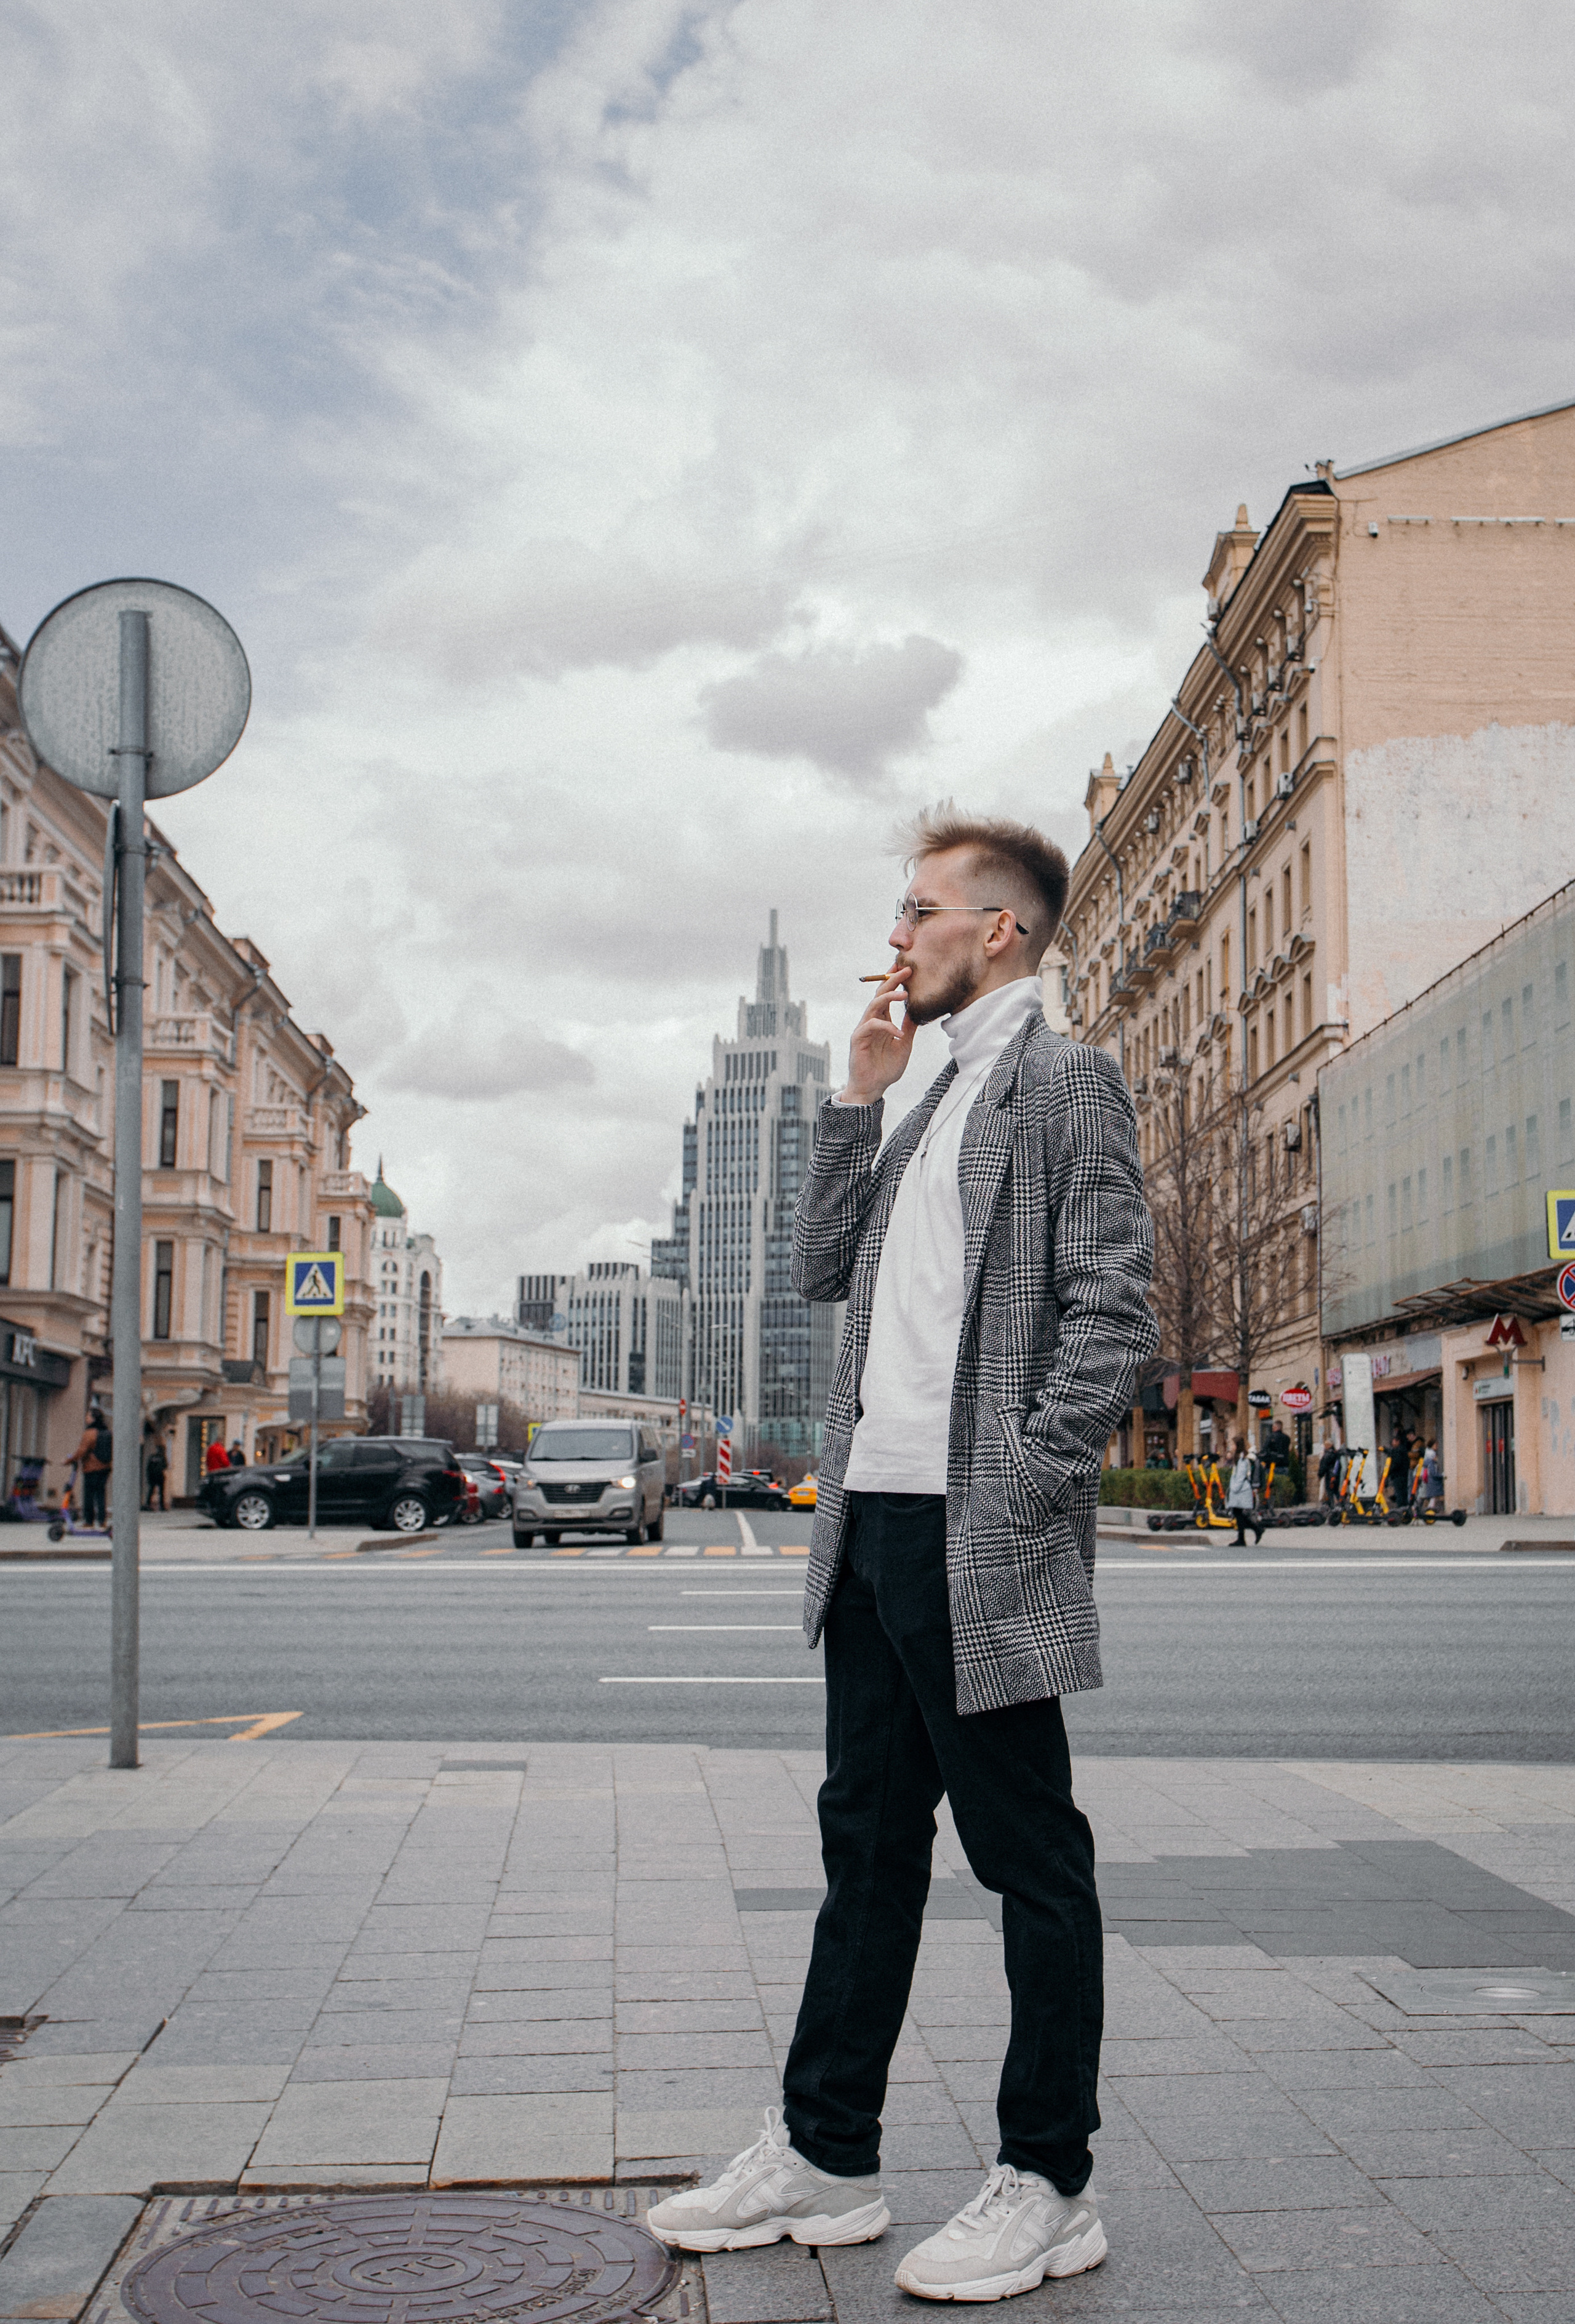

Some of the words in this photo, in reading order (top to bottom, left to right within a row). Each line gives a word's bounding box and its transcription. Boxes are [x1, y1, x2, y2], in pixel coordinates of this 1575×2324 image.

[1248, 1395, 1270, 1404] ТАБАК
[1282, 1393, 1310, 1404] ЦВЕТЫ
[362, 2255, 456, 2285] ГТС
